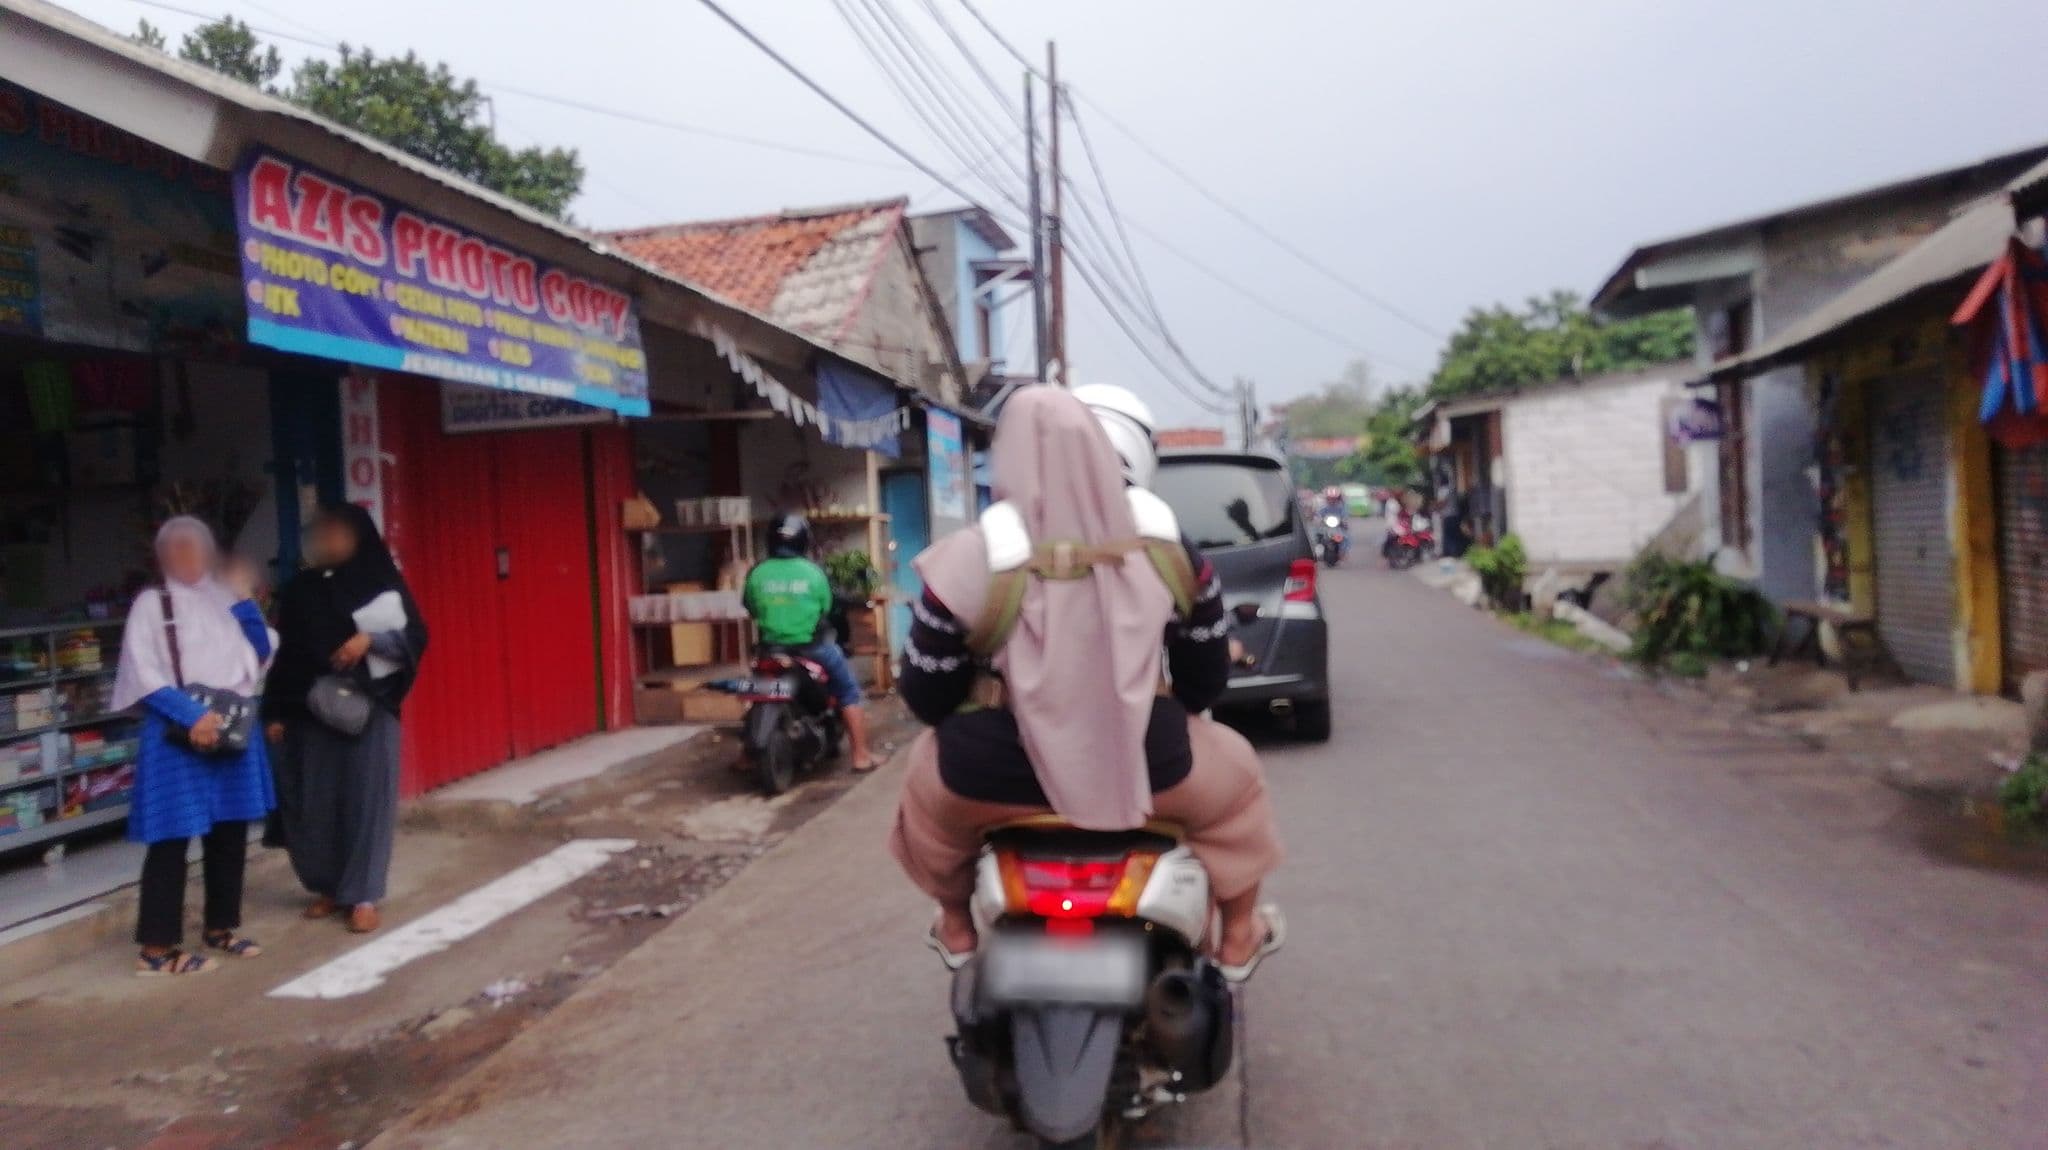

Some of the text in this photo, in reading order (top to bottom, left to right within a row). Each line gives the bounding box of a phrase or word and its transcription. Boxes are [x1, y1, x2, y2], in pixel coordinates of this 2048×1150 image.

[249, 157, 630, 341] AZIS PHOTO COPY
[260, 242, 380, 296] PHOTO COPY
[264, 283, 301, 316] ATK
